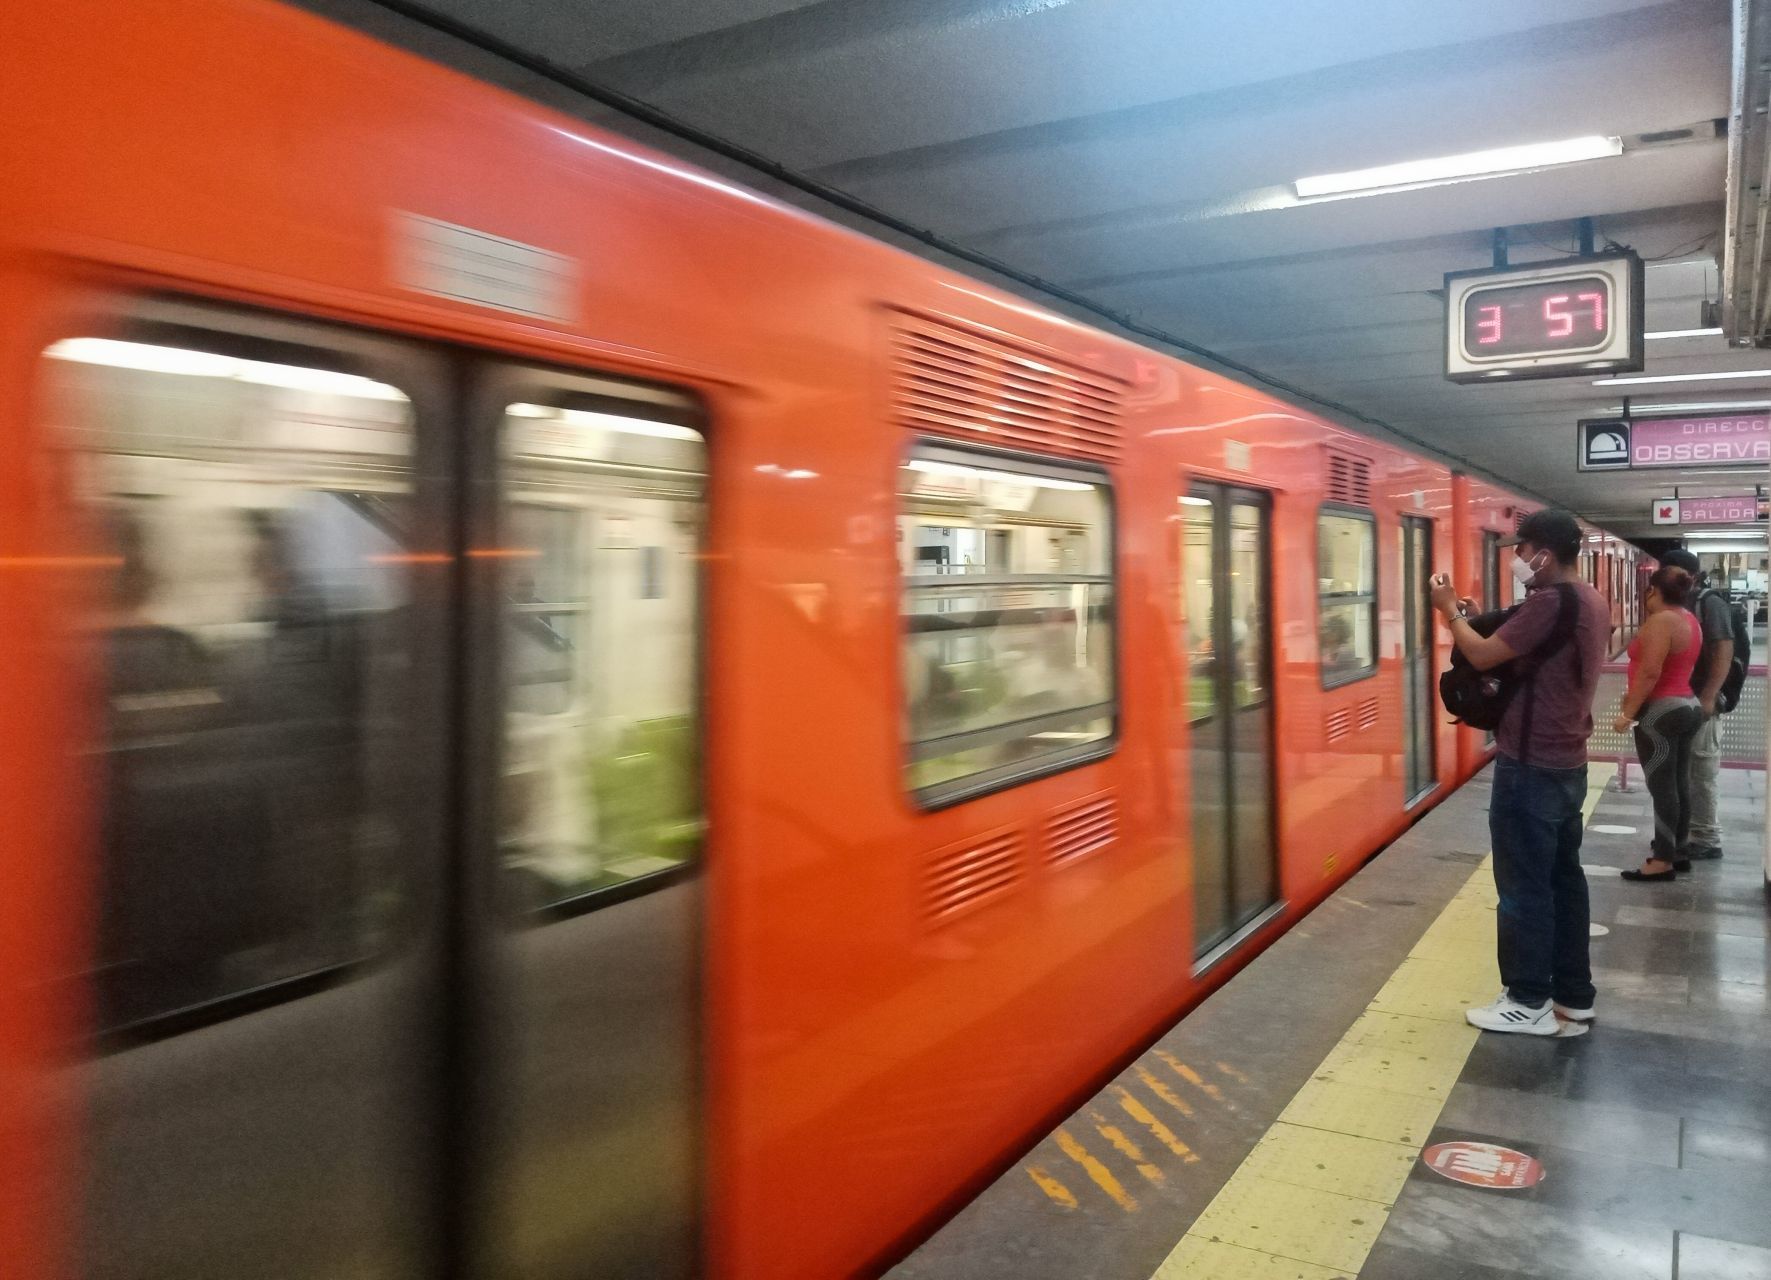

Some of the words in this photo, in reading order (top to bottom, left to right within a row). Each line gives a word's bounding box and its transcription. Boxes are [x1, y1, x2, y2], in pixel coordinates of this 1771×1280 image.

[1478, 306, 1501, 343] 3
[1545, 293, 1603, 337] 57
[1681, 508, 1755, 520] SALIDA
